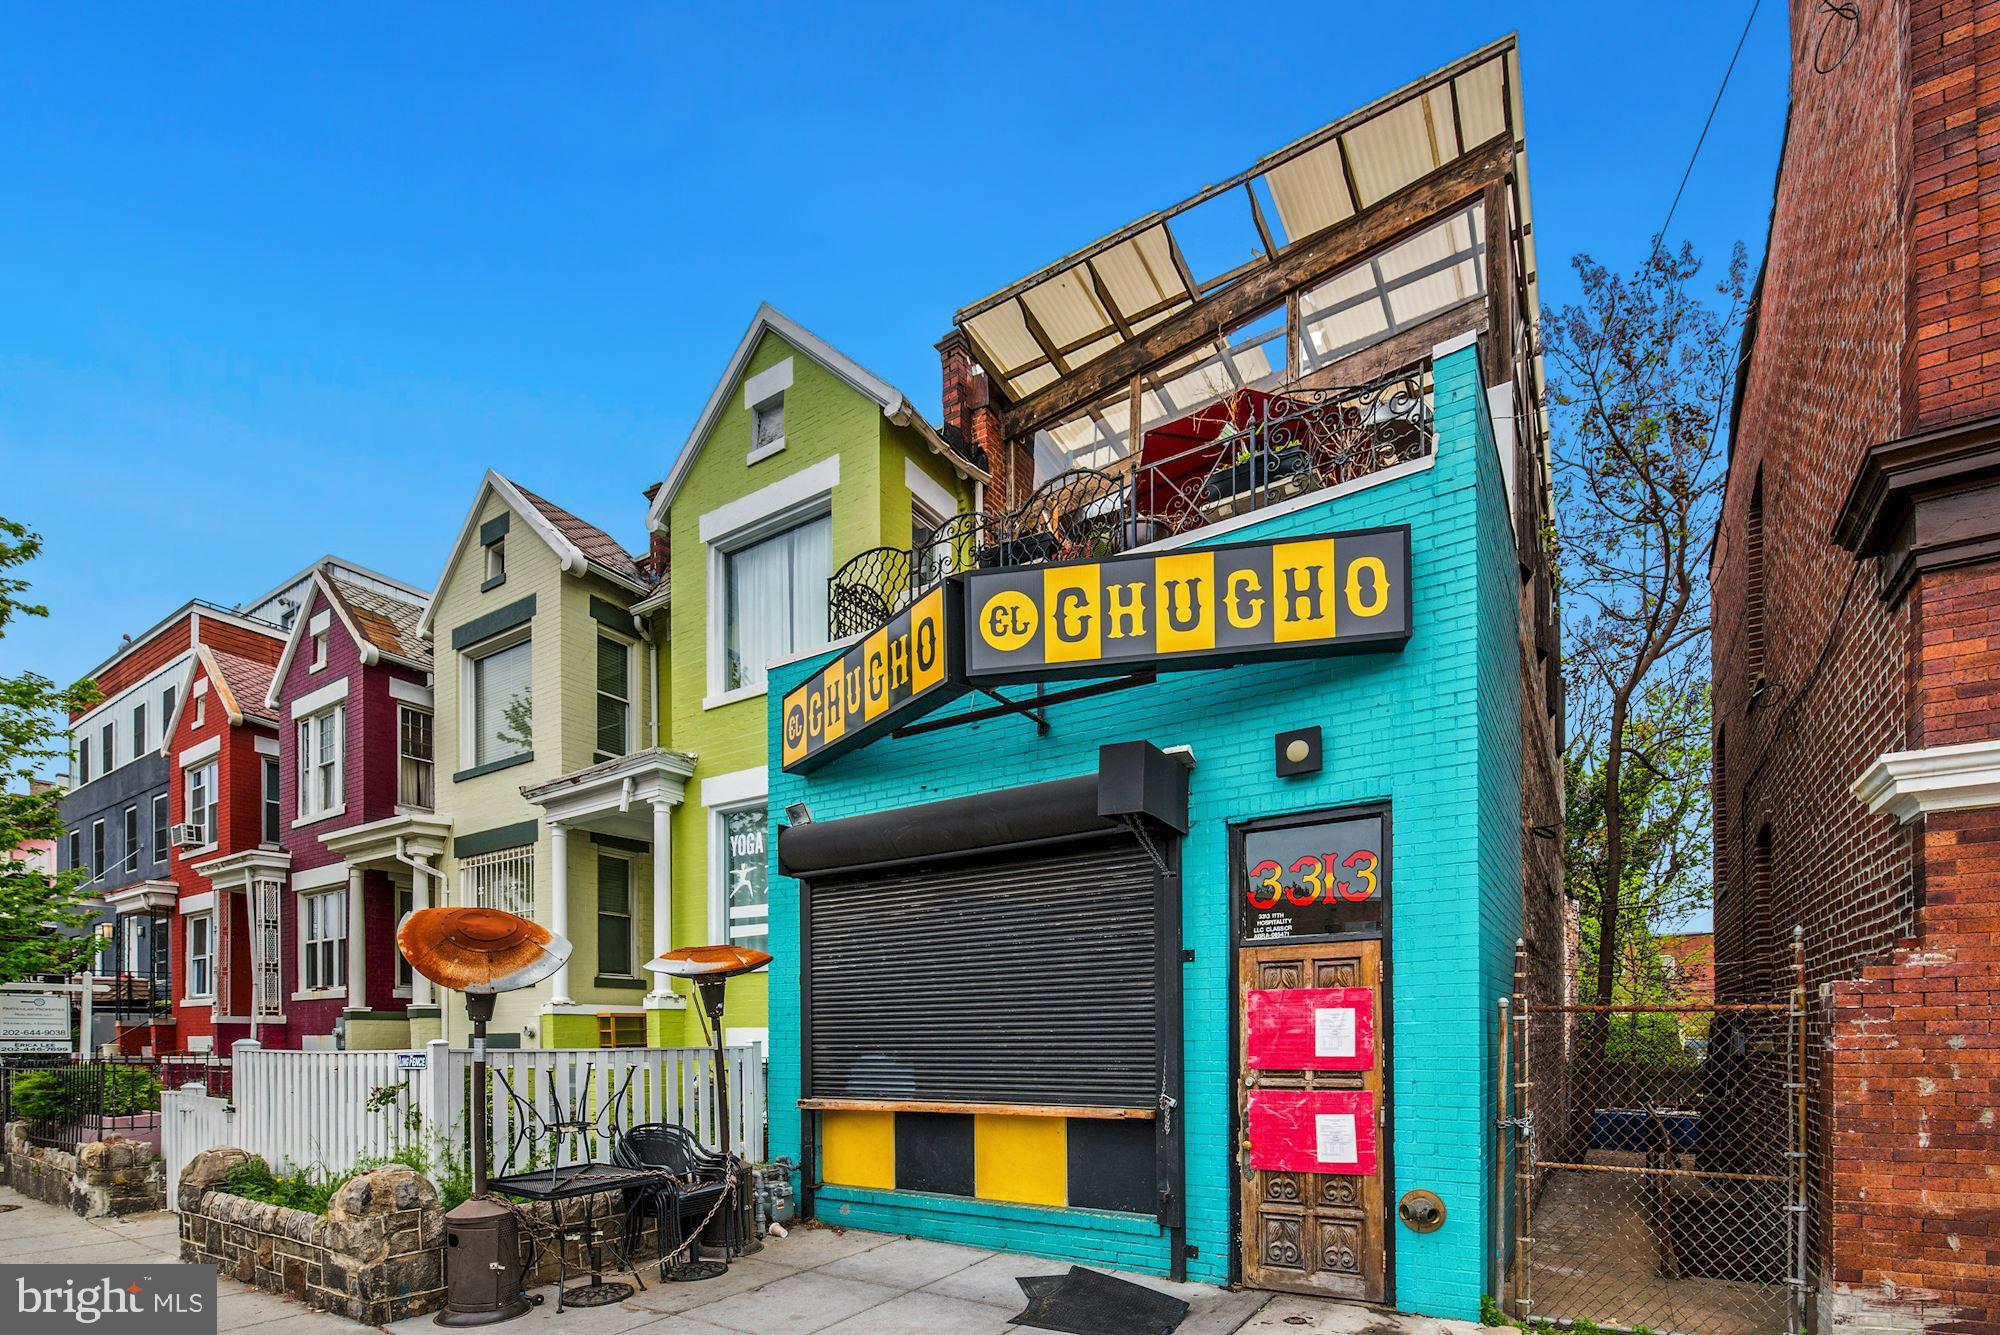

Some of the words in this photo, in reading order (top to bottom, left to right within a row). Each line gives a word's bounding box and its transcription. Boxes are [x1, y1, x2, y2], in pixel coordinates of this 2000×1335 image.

[988, 603, 1031, 637] EL
[1053, 556, 1391, 643] CHUCHO
[788, 711, 803, 741] EL
[808, 616, 936, 737] CHUCHO
[730, 831, 764, 857] YOGA
[1246, 849, 1378, 910] 3313
[1256, 918, 1292, 926] HOSPITALITY
[408, 1055, 426, 1067] FENCE
